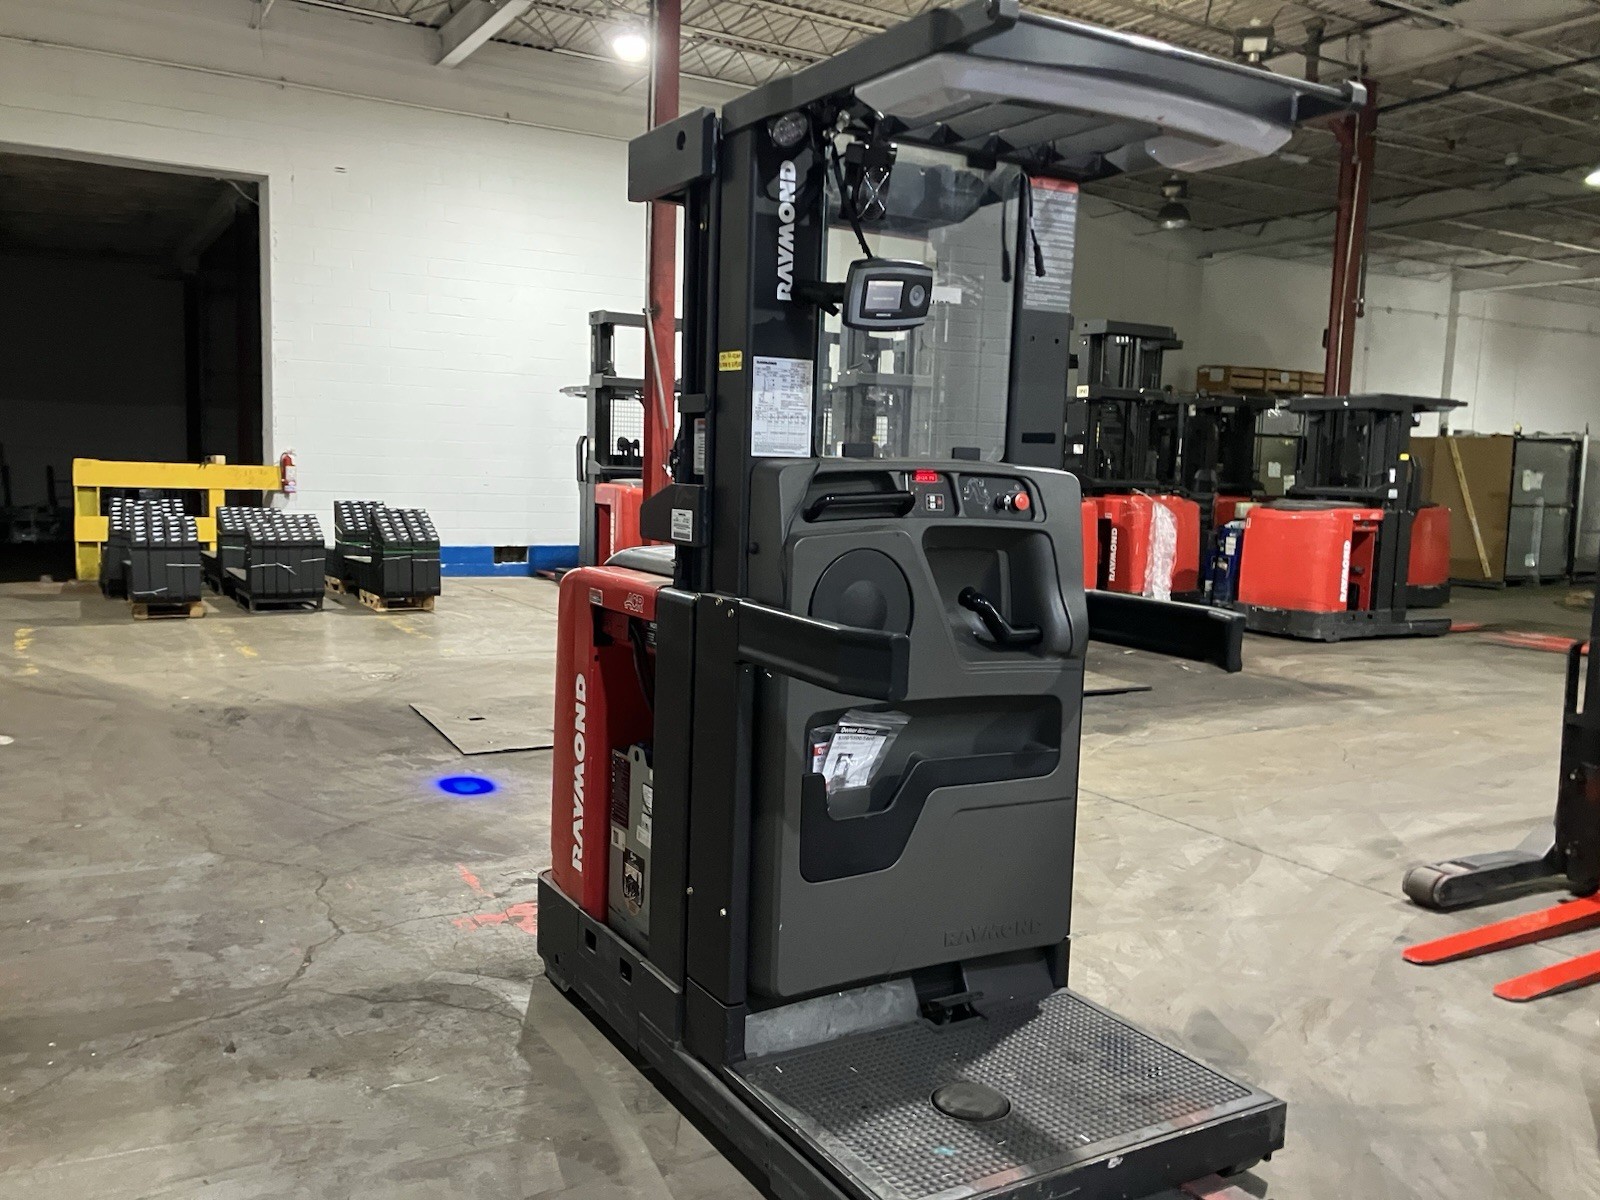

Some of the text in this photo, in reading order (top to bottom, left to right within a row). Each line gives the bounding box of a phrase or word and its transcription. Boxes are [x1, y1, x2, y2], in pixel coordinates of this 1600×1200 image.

[777, 160, 796, 301] RAYMOND
[1109, 528, 1118, 581] RAYMOND
[1339, 540, 1351, 603] RAYMOND
[571, 673, 588, 873] RAYMOND
[944, 919, 1040, 947] RAYMOND
